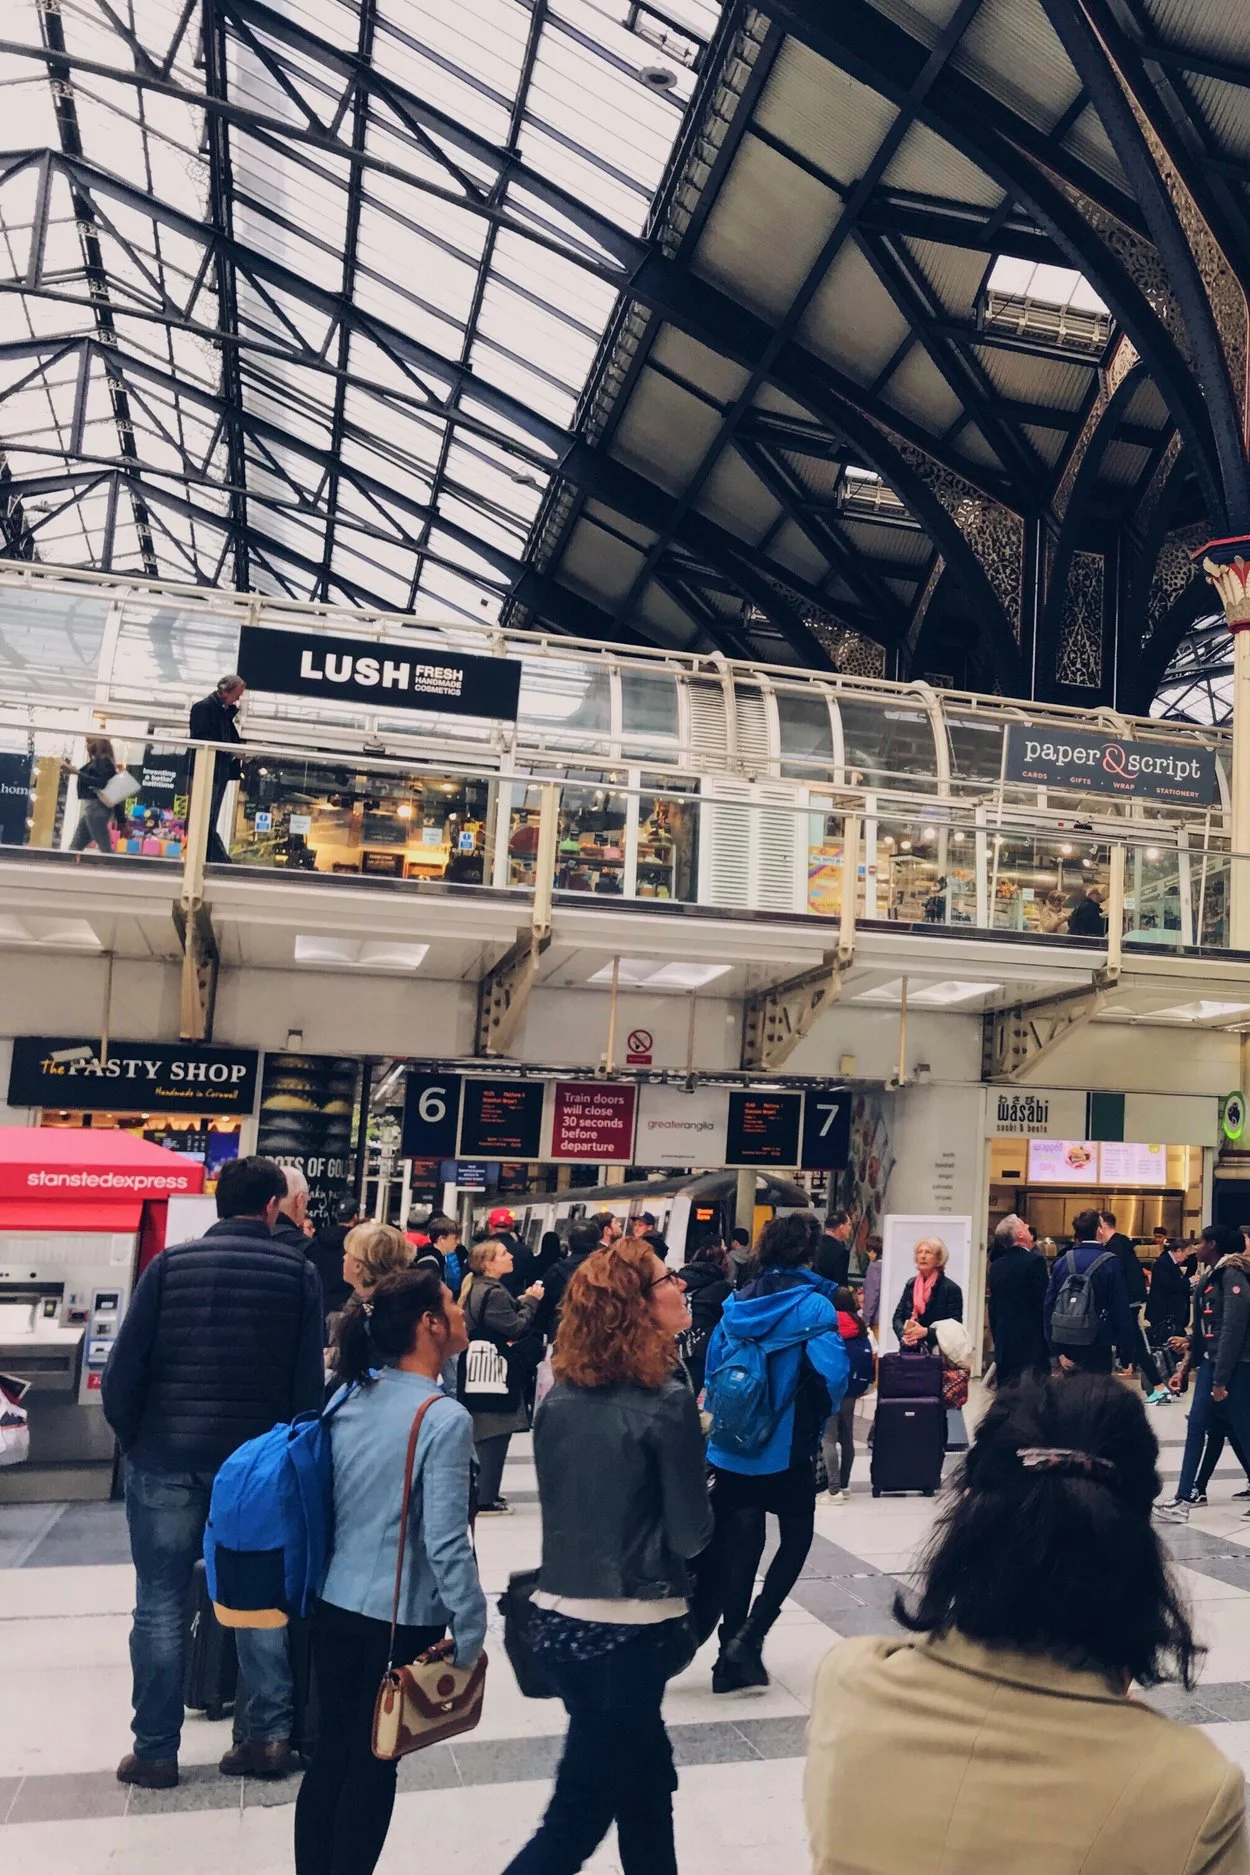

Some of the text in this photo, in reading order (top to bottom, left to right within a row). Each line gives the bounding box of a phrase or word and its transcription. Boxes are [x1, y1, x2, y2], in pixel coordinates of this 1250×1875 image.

[300, 650, 463, 690] LUSH FRESH
[415, 676, 462, 688] HANDMADE
[415, 684, 461, 696] COSMETICS
[1024, 740, 1200, 781] paper & script
[143, 767, 177, 779] Inventing
[151, 775, 174, 783] better
[142, 780, 175, 789] bathtime
[1022, 771, 1200, 798] CARDS GIFTS WRAP STATIONERY
[40, 1058, 247, 1083] The PASTY SHOP
[155, 1087, 194, 1098] Handmade
[205, 1088, 239, 1099] Cornwall
[564, 1092, 625, 1105] Train doors
[418, 1086, 446, 1122] 6
[563, 1105, 613, 1116] will close
[997, 1100, 1049, 1123] wasabi
[563, 1116, 624, 1129] 30 seconds
[648, 1120, 714, 1132] greateranglia
[816, 1104, 839, 1137] 7
[562, 1128, 598, 1139] before
[997, 1123, 1017, 1132] sushi
[560, 1140, 614, 1153] departure
[307, 1157, 326, 1178] OF
[27, 1170, 188, 1190] stanstedexpress
